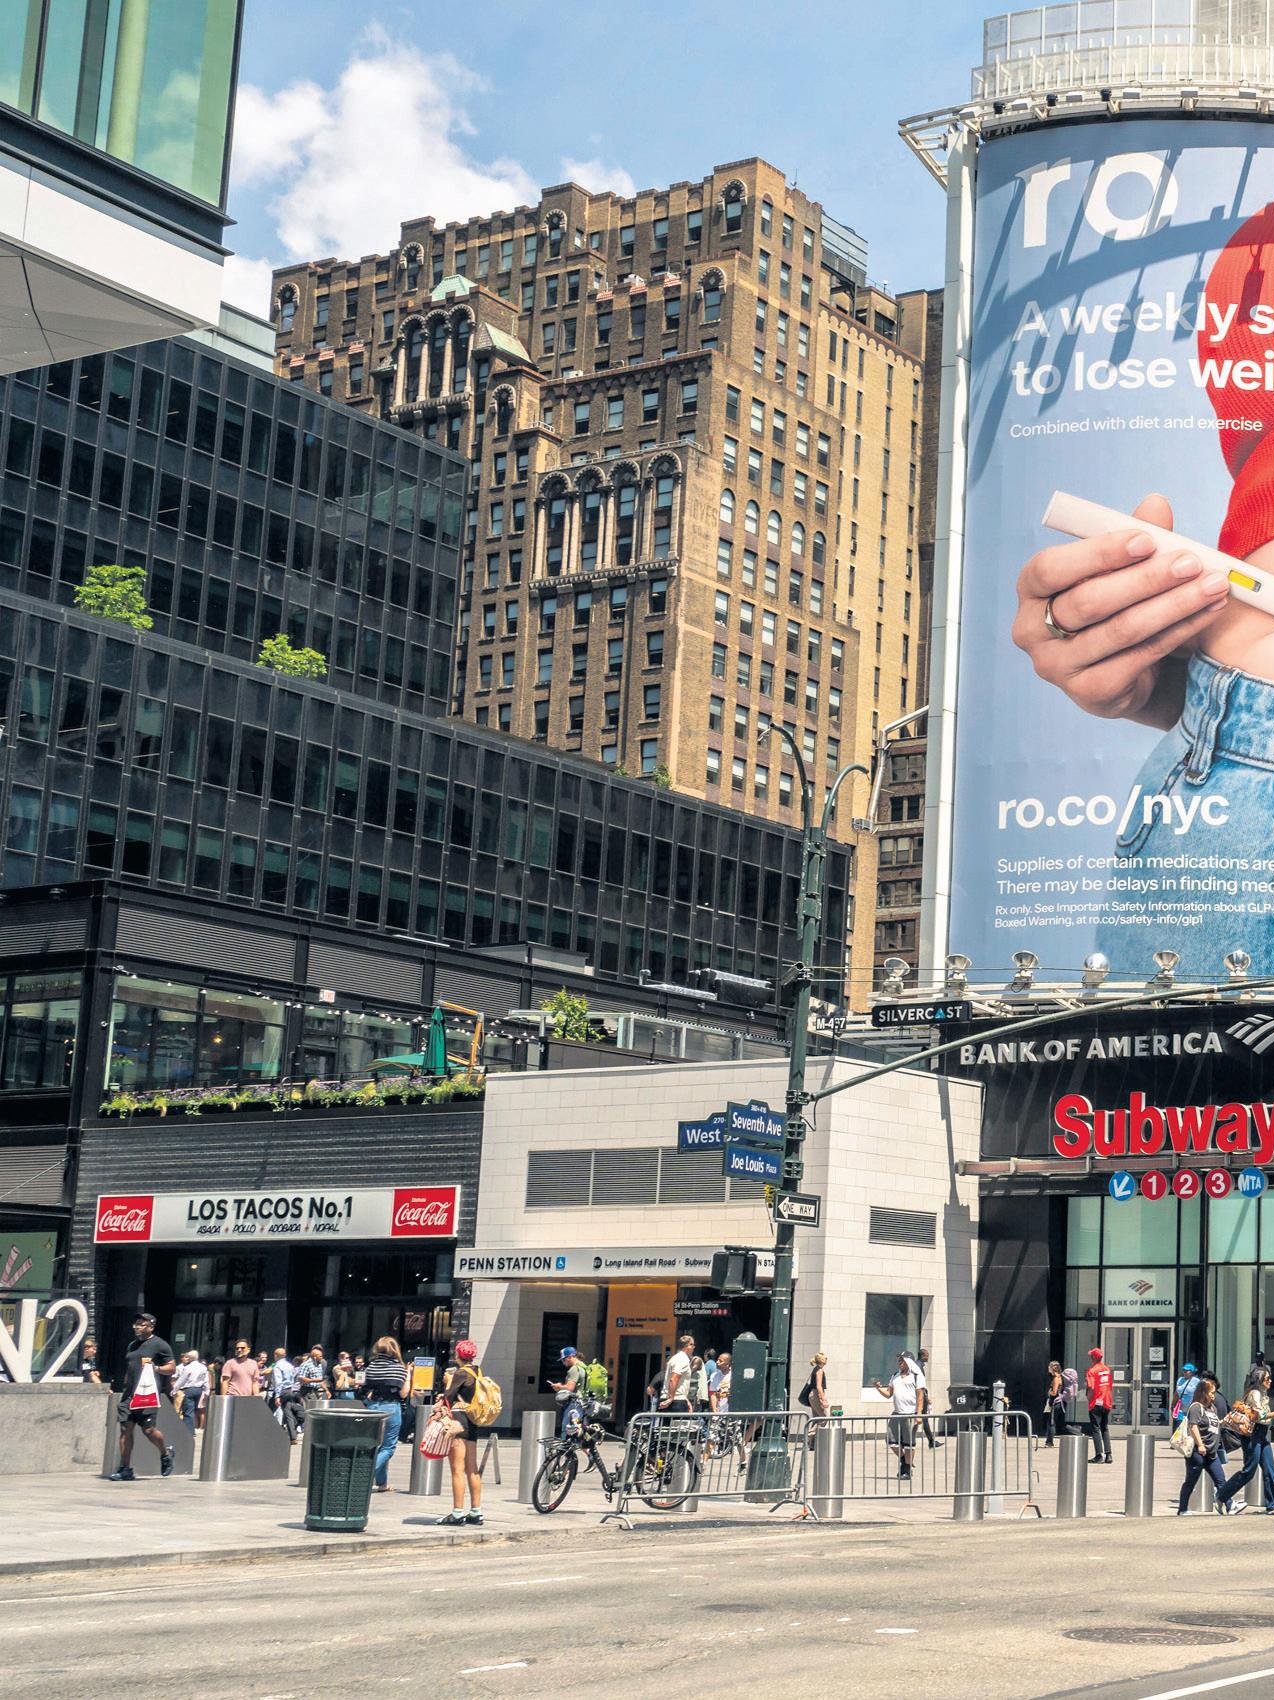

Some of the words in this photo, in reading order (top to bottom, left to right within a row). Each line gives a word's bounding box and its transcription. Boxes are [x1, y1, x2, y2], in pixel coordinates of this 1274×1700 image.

[1015, 152, 1178, 248] ro
[1013, 300, 1050, 341] A
[1062, 291, 1239, 342] weekly
[1012, 358, 1062, 396] to
[1074, 351, 1177, 391] lose
[1010, 417, 1089, 438] Combined
[1093, 416, 1126, 431] with
[1129, 415, 1160, 430] diet
[1164, 416, 1193, 430] and
[1198, 416, 1263, 432] exercise
[998, 784, 1230, 836] ro.co/nyc
[997, 856, 1064, 876] Supplies
[1066, 855, 1084, 870] of
[1086, 854, 1143, 869] certain
[1146, 854, 1249, 869] medications
[997, 880, 1041, 895] There
[1044, 880, 1079, 894] may
[1082, 877, 1103, 891] be
[1106, 876, 1159, 893] delays
[1162, 876, 1177, 890] in
[1180, 876, 1238, 895] finding
[995, 906, 1008, 916] Rx
[1010, 904, 1033, 915] only.
[1034, 903, 1055, 913] See
[1056, 902, 1109, 914] Important
[1111, 901, 1146, 913] Safety
[1148, 901, 1212, 912] Information
[1213, 902, 1246, 913] about
[995, 917, 1027, 928] Boxed
[1028, 915, 1075, 927] Warning,
[1076, 916, 1087, 925] at
[1088, 914, 1203, 927] ro.co/safety-info/glp1
[878, 1004, 964, 1023] SILVERCAST
[959, 1040, 1037, 1066] BANK
[1043, 1038, 1081, 1061] OF
[1085, 1031, 1224, 1060] AMERICA
[732, 1112, 765, 1134] Seventh
[766, 1119, 782, 1136] Ave
[686, 1128, 721, 1144] West
[730, 1153, 744, 1171] Joe
[745, 1155, 765, 1173] Louis
[765, 1163, 777, 1174] Plaza
[1238, 1173, 1262, 1192] MTA
[188, 1199, 229, 1221] LOS
[233, 1197, 304, 1220] TACOS
[309, 1196, 353, 1219] No.1
[395, 1201, 453, 1227] Coca-Cola
[783, 1203, 794, 1214] ONE
[800, 1204, 813, 1216] WAY
[99, 1209, 150, 1233] Coca-Cola
[197, 1225, 221, 1235] ASADA
[232, 1223, 257, 1234] POLLO
[312, 1223, 340, 1233] NOPAL
[459, 1257, 495, 1271] PENN
[497, 1256, 552, 1270] STATION
[605, 1259, 622, 1268] Long
[623, 1258, 642, 1266] Island
[644, 1258, 657, 1266] Rail
[658, 1258, 677, 1266] Road
[684, 1258, 712, 1267] Subway
